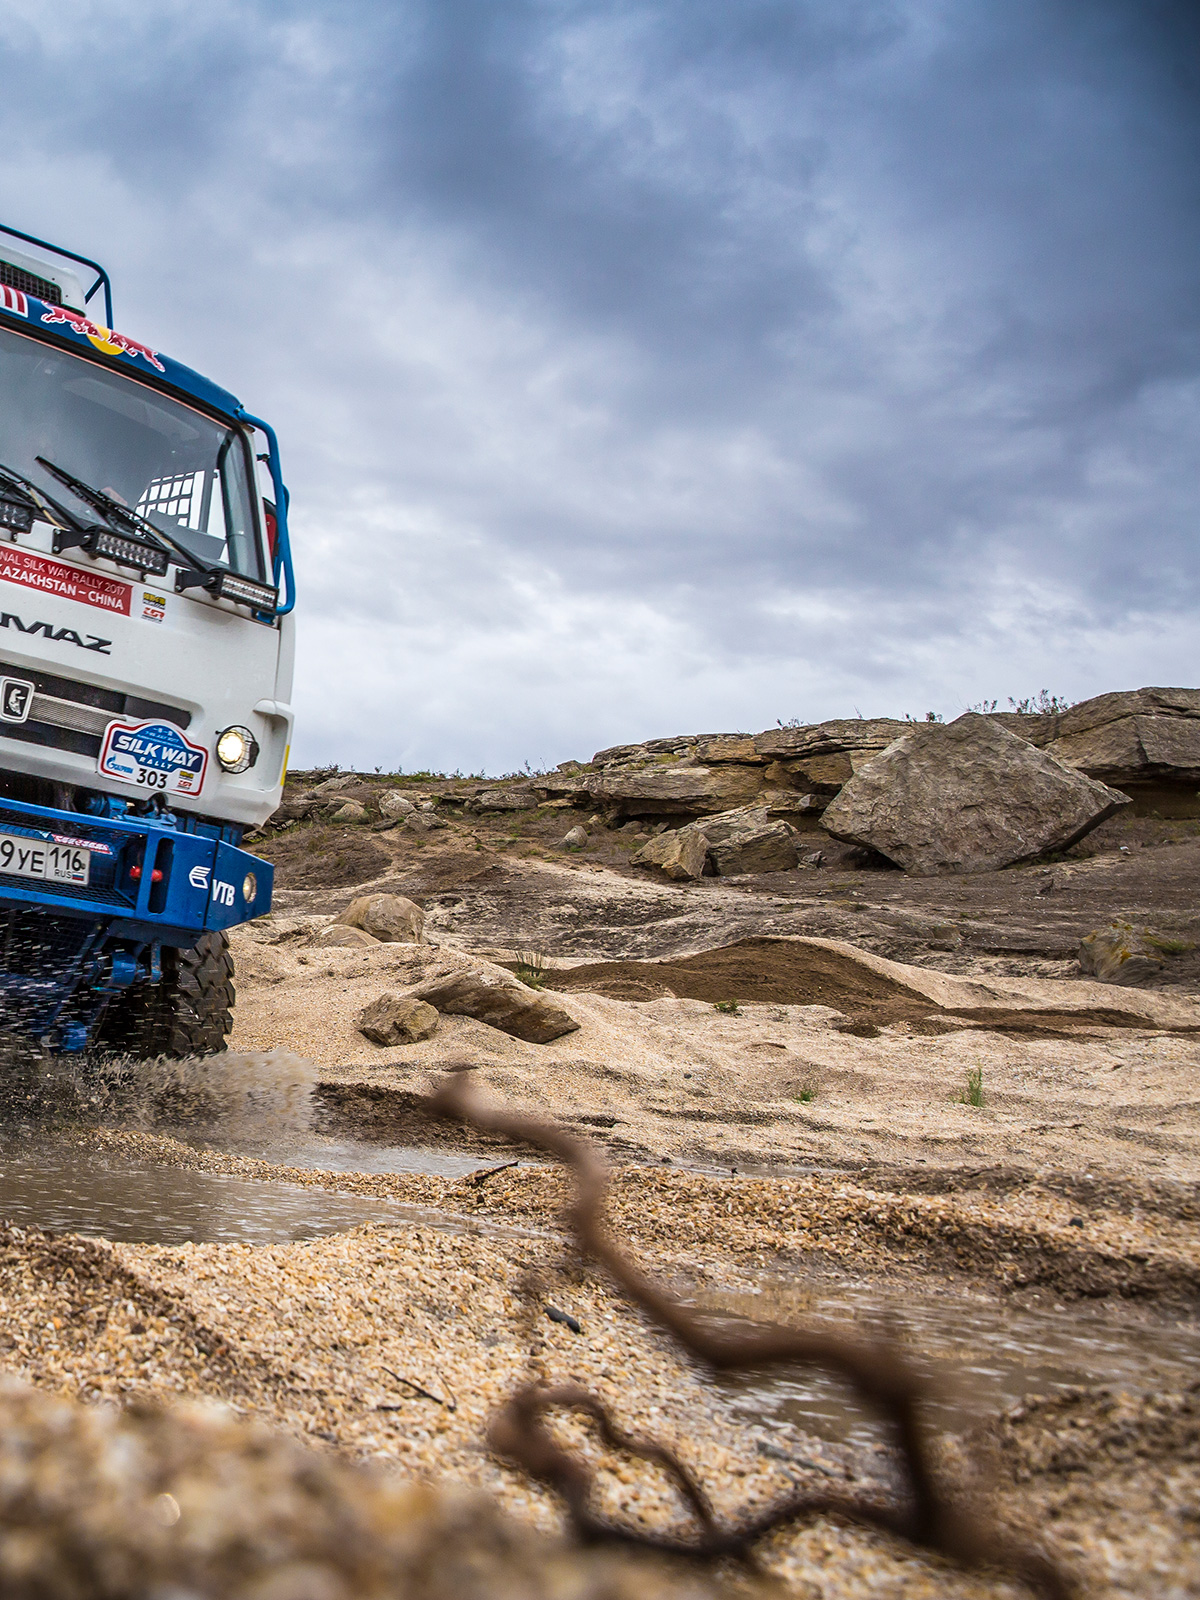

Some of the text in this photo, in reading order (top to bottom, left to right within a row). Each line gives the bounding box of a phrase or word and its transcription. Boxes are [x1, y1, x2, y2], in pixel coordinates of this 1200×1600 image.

[23, 557, 45, 573] SILK
[47, 565, 70, 580] WAY
[71, 572, 102, 589] RALLY
[104, 582, 126, 596] 2017
[88, 590, 124, 611] CHINA
[115, 735, 161, 758] SILK
[161, 746, 200, 767] WAY
[139, 757, 173, 769] RALLY
[137, 768, 168, 789] 303
[49, 847, 82, 871] 116
[54, 869, 72, 879] RUS
[212, 879, 235, 906] VTB
